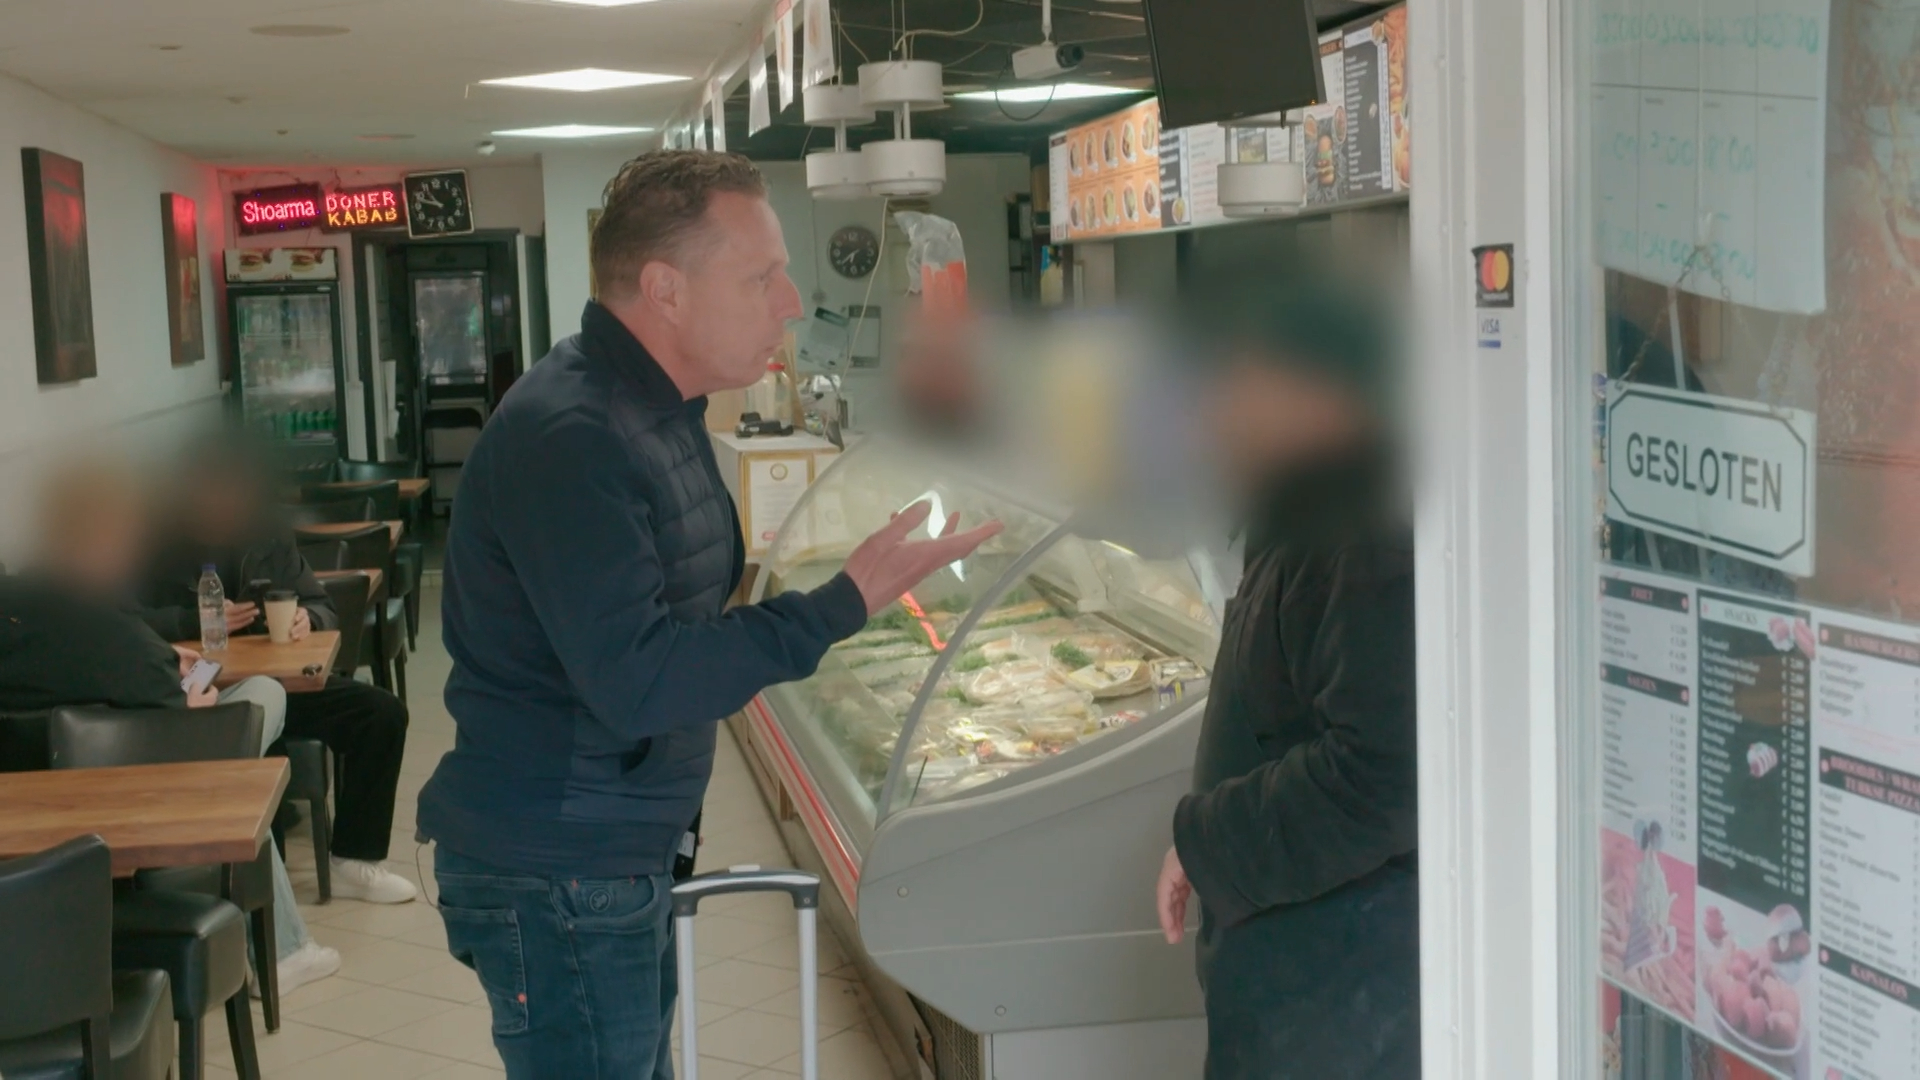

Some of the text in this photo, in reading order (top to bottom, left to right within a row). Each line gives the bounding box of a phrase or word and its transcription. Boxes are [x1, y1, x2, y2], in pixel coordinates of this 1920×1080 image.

[243, 200, 316, 223] Shoarma
[327, 207, 398, 228] KABAB
[1481, 318, 1500, 334] VISA
[1626, 431, 1782, 513] GESLOTEN
